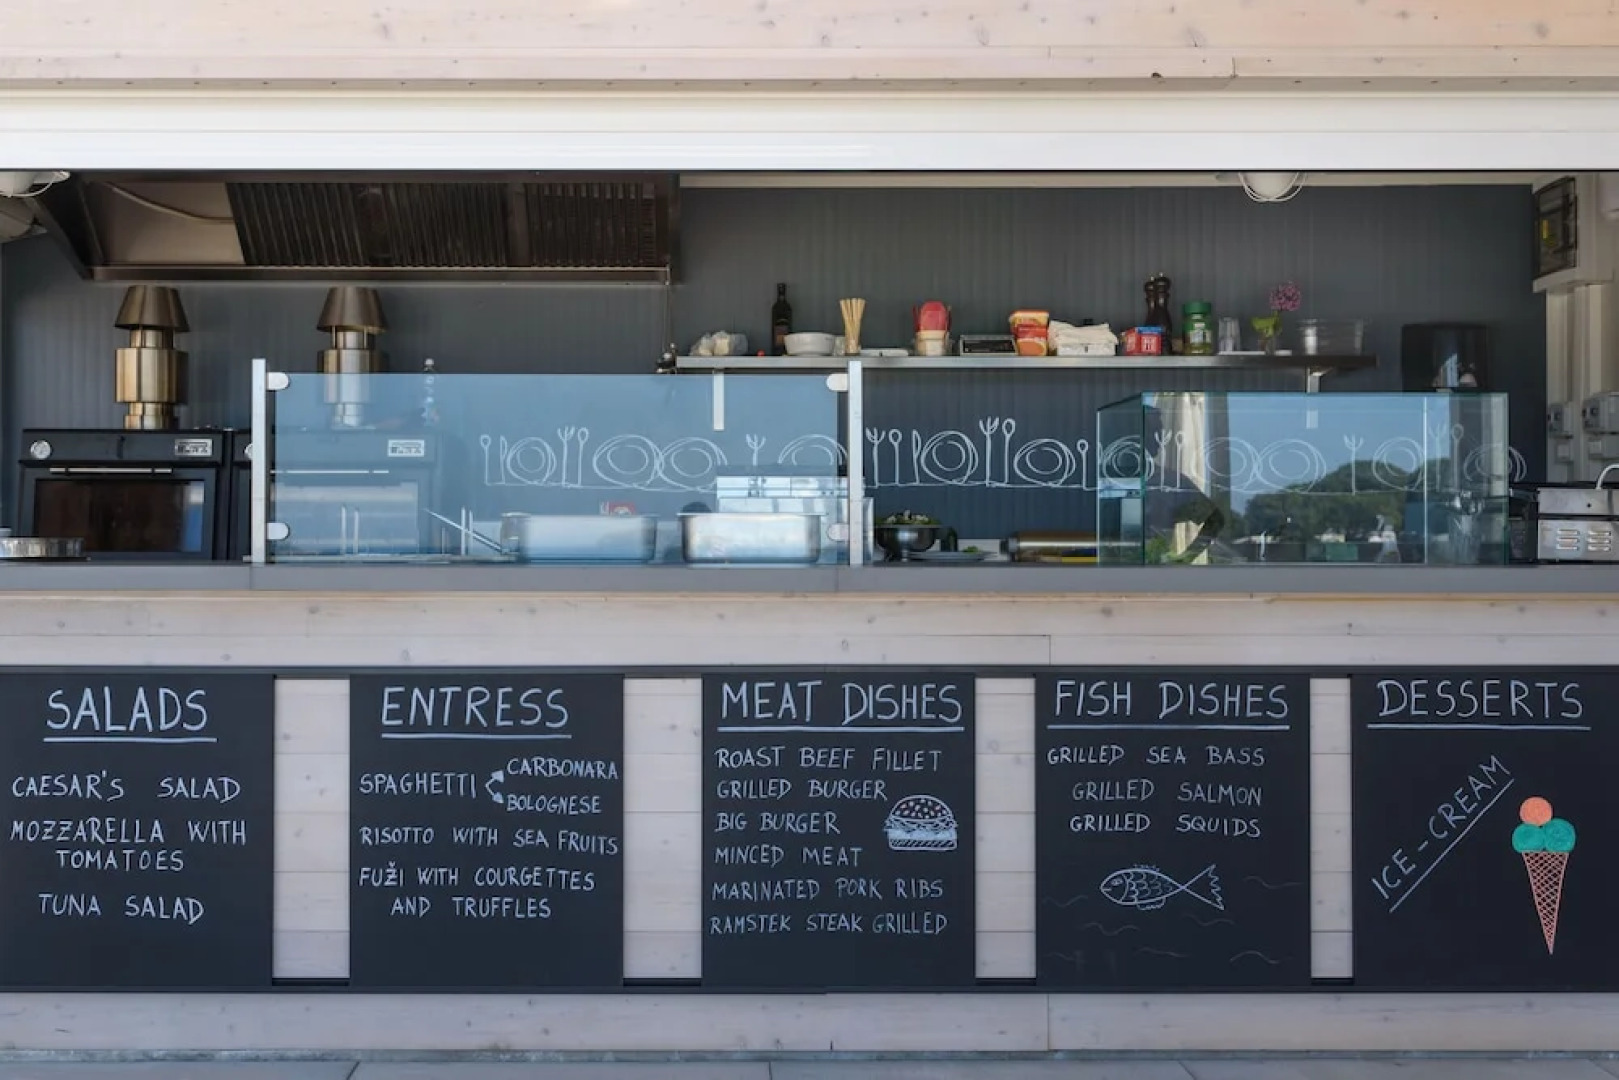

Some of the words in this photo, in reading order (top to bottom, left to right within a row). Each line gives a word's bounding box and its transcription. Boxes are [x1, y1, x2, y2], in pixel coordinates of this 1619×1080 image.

[46, 685, 208, 733] SALADS
[381, 686, 569, 728] ENTRESS
[721, 680, 823, 723] MEAT
[841, 682, 964, 726] DISHES
[1055, 680, 1132, 717] FISH
[1158, 681, 1289, 720] DISHES
[1377, 680, 1583, 719] DESSERTS
[506, 757, 619, 780] CARBONARA
[714, 746, 786, 769] ROAST
[799, 747, 856, 770] BEEF
[872, 747, 942, 772] FILLET
[1047, 745, 1125, 766] GRILLED
[1146, 746, 1187, 765] SEA
[1206, 746, 1265, 767] BASS
[12, 770, 125, 802] CAESAR'S
[157, 776, 241, 804] SALAD
[359, 773, 477, 799] SPAGHETTI
[716, 779, 792, 800] GRILLED
[808, 779, 888, 801] BURGER
[1072, 779, 1155, 802] GRILLED
[1177, 782, 1262, 806] SALMON
[506, 794, 602, 815] BOLOGNESE
[10, 817, 165, 845] MOZZARELLA
[187, 820, 247, 846] WITH
[714, 812, 748, 833] BIG
[759, 812, 841, 835] BURGER
[1069, 813, 1151, 833] GRILLED
[1175, 814, 1262, 838] SQUIDS
[359, 827, 435, 846] RISOTTO
[453, 827, 498, 847] WITH
[512, 829, 550, 848] SEA
[558, 830, 618, 856] FRUITS
[56, 850, 184, 872] TOMATOES
[714, 844, 785, 867] MINCED
[802, 847, 863, 867] MEAT
[359, 861, 405, 887] FUŽI
[417, 867, 459, 886] WITH
[474, 867, 596, 892] COURGETTES
[712, 878, 820, 902] MARINATED
[835, 877, 883, 900] PORK
[895, 877, 943, 899] RIBS
[38, 894, 102, 917] TUNA
[125, 895, 205, 925] SALAD
[390, 896, 431, 918] AND
[452, 896, 552, 919] TRUFFLES
[710, 914, 792, 935] RAMSTEK
[807, 913, 863, 932] STEAK
[872, 911, 948, 935] GRILLED
